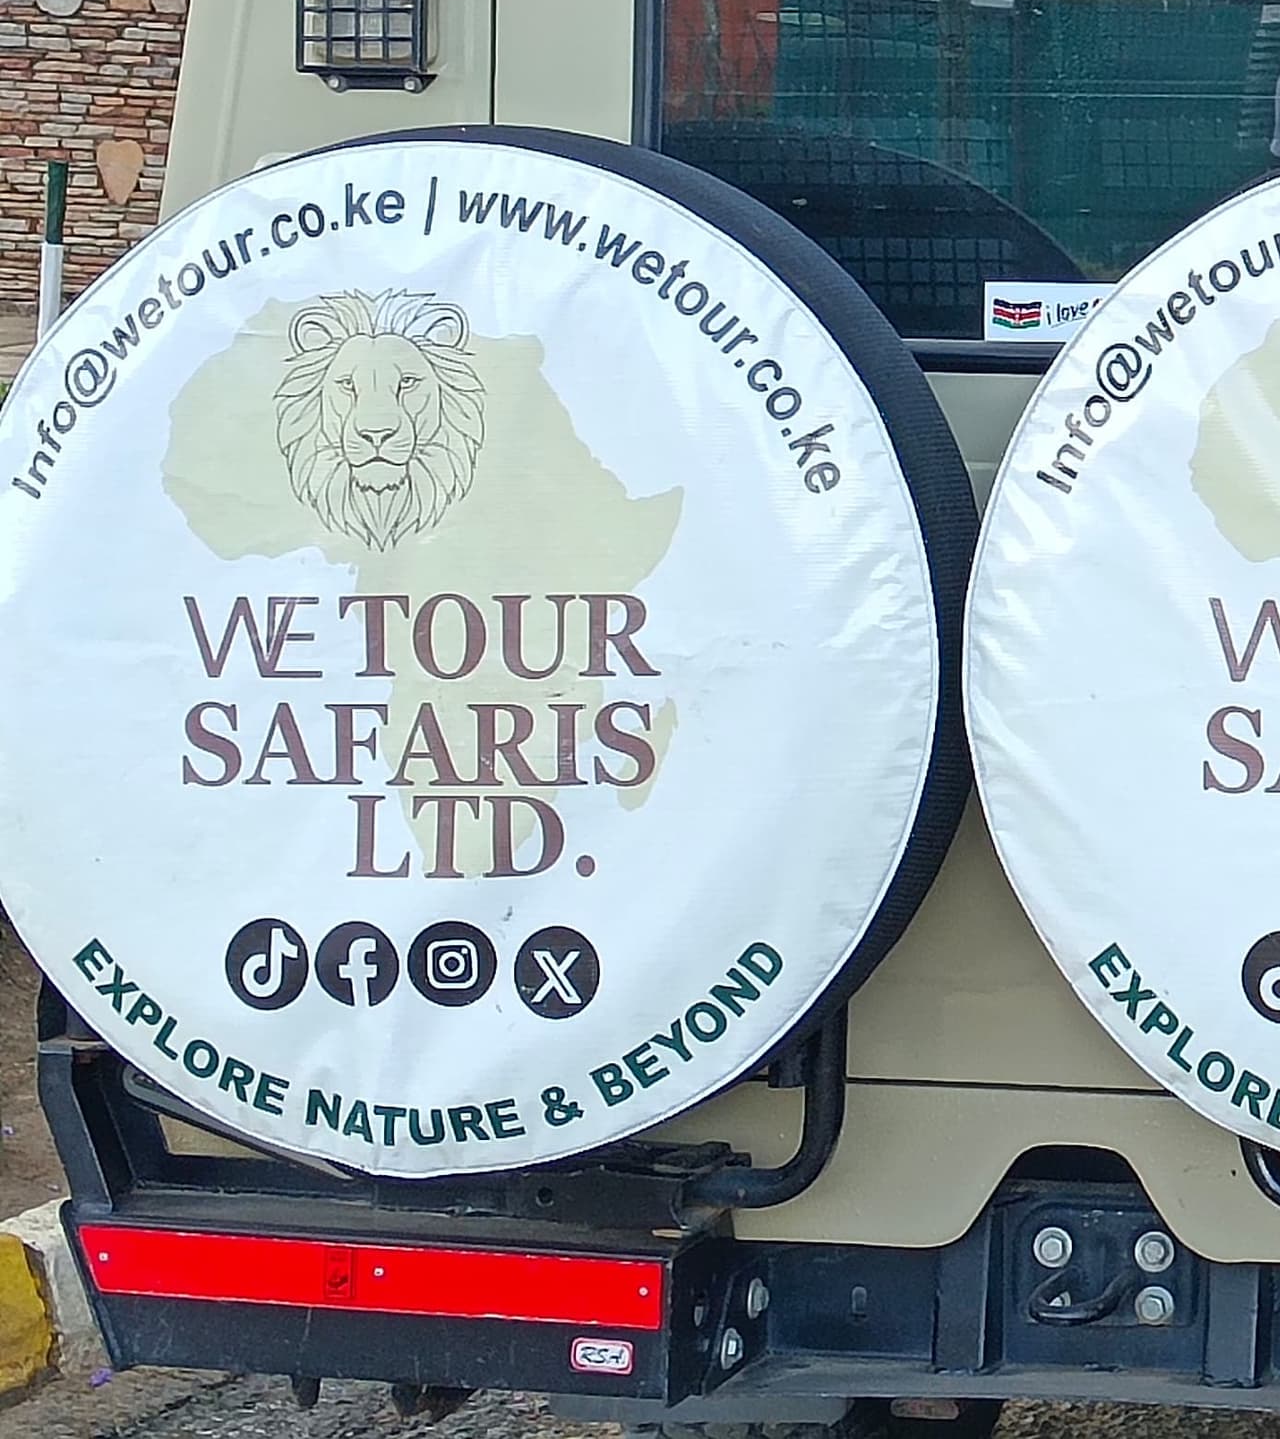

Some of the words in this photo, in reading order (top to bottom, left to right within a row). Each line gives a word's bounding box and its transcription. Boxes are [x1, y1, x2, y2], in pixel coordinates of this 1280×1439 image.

[11, 182, 405, 499] Info@wetour.co.ke
[458, 189, 841, 495] www.wetour.co.ke
[1056, 301, 1089, 324] love
[183, 594, 323, 678] WE
[339, 592, 661, 679] TOUR
[181, 701, 658, 787] SAFARIS
[346, 793, 597, 879] LTD.
[72, 937, 288, 1116] EXPLORE
[306, 1090, 526, 1148] NATURE
[541, 1085, 586, 1127] &
[590, 941, 785, 1109] BEYOND
